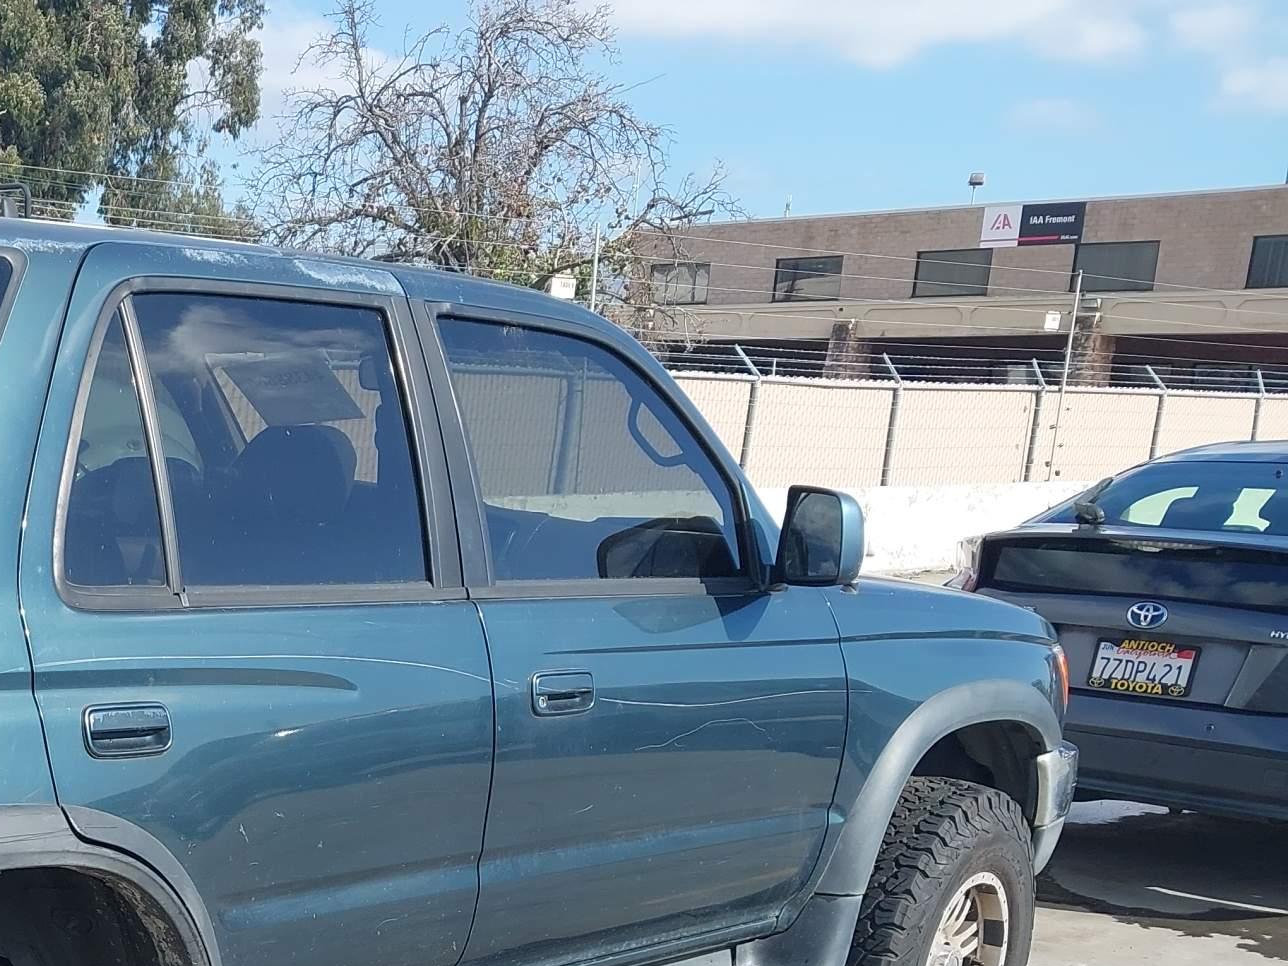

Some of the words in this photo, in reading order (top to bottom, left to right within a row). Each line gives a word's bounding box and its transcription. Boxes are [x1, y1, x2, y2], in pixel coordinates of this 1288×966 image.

[1029, 215, 1044, 225] IAA
[1045, 214, 1076, 224] Fremont
[1120, 639, 1176, 653] ANTIOCH
[1100, 656, 1183, 686] 7ZDP421
[1110, 679, 1163, 695] TOYOTA
